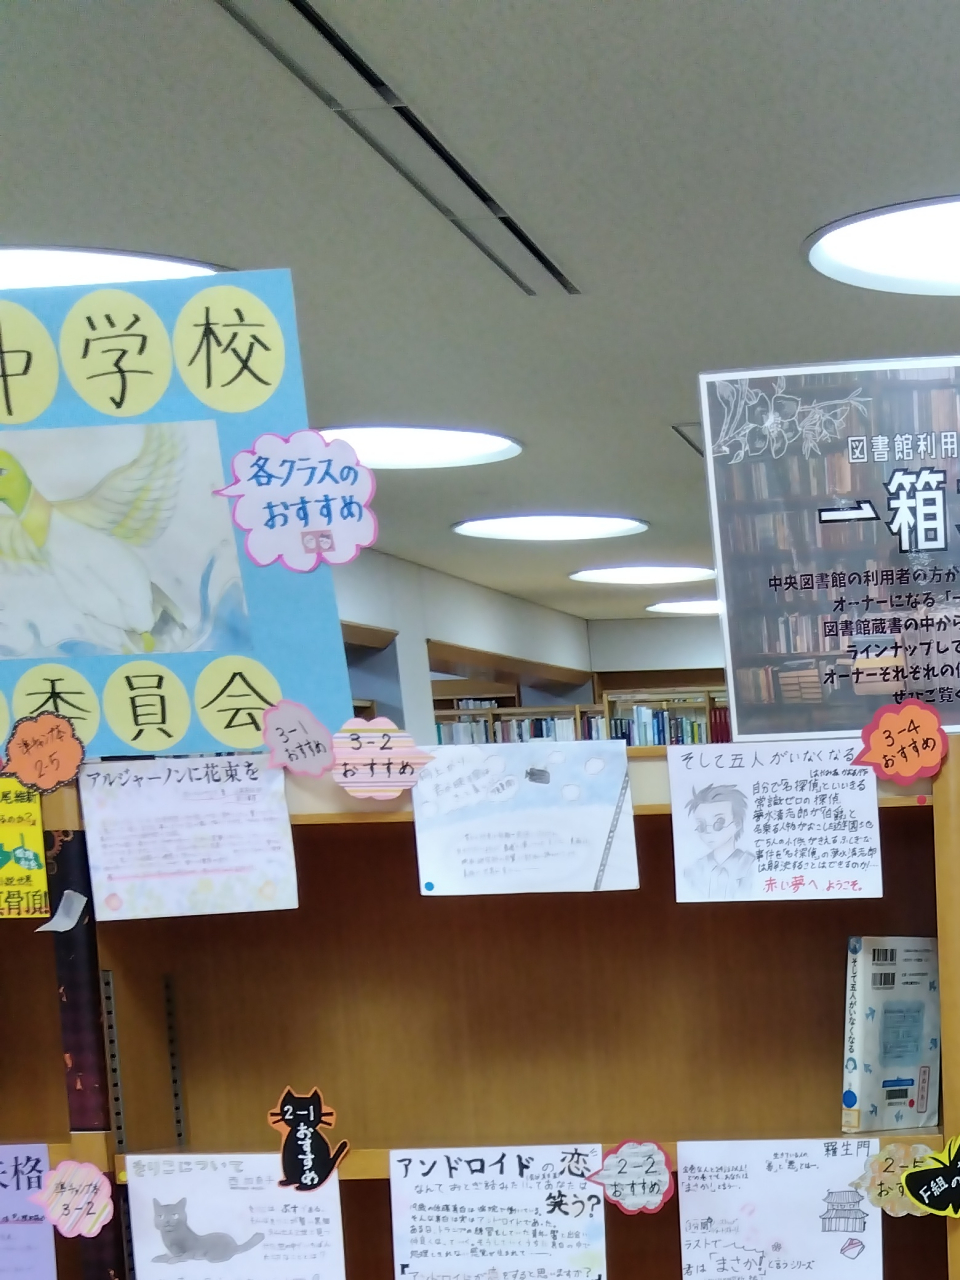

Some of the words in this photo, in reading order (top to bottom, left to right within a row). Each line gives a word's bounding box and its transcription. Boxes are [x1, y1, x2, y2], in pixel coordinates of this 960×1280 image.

[248, 456, 359, 487] 各クラスの
[262, 495, 364, 529] おすすめ
[275, 718, 308, 744] 3-1
[349, 733, 394, 752] 3-2
[882, 718, 921, 747] 3-4
[282, 737, 328, 764] おすすめ
[681, 746, 855, 770] そして五人がいなくなる
[881, 736, 937, 770] おすすめ
[86, 761, 261, 789] アルジャーノンに花束を
[341, 757, 416, 779] おすすめ
[848, 957, 857, 1054] そして五人がいなくなる
[283, 1104, 316, 1121] 2-1
[297, 1122, 320, 1186] おすすめ
[823, 1140, 872, 1159] 羅生門
[132, 1159, 245, 1177] きりこについて
[396, 1148, 593, 1179] アンドロイドの恋
[617, 1154, 656, 1176] 2-2
[611, 1180, 662, 1198] おすすめ
[61, 1202, 98, 1217] 3-2
[545, 1190, 602, 1219] 笑う?
[684, 1238, 723, 1251] ラストで
